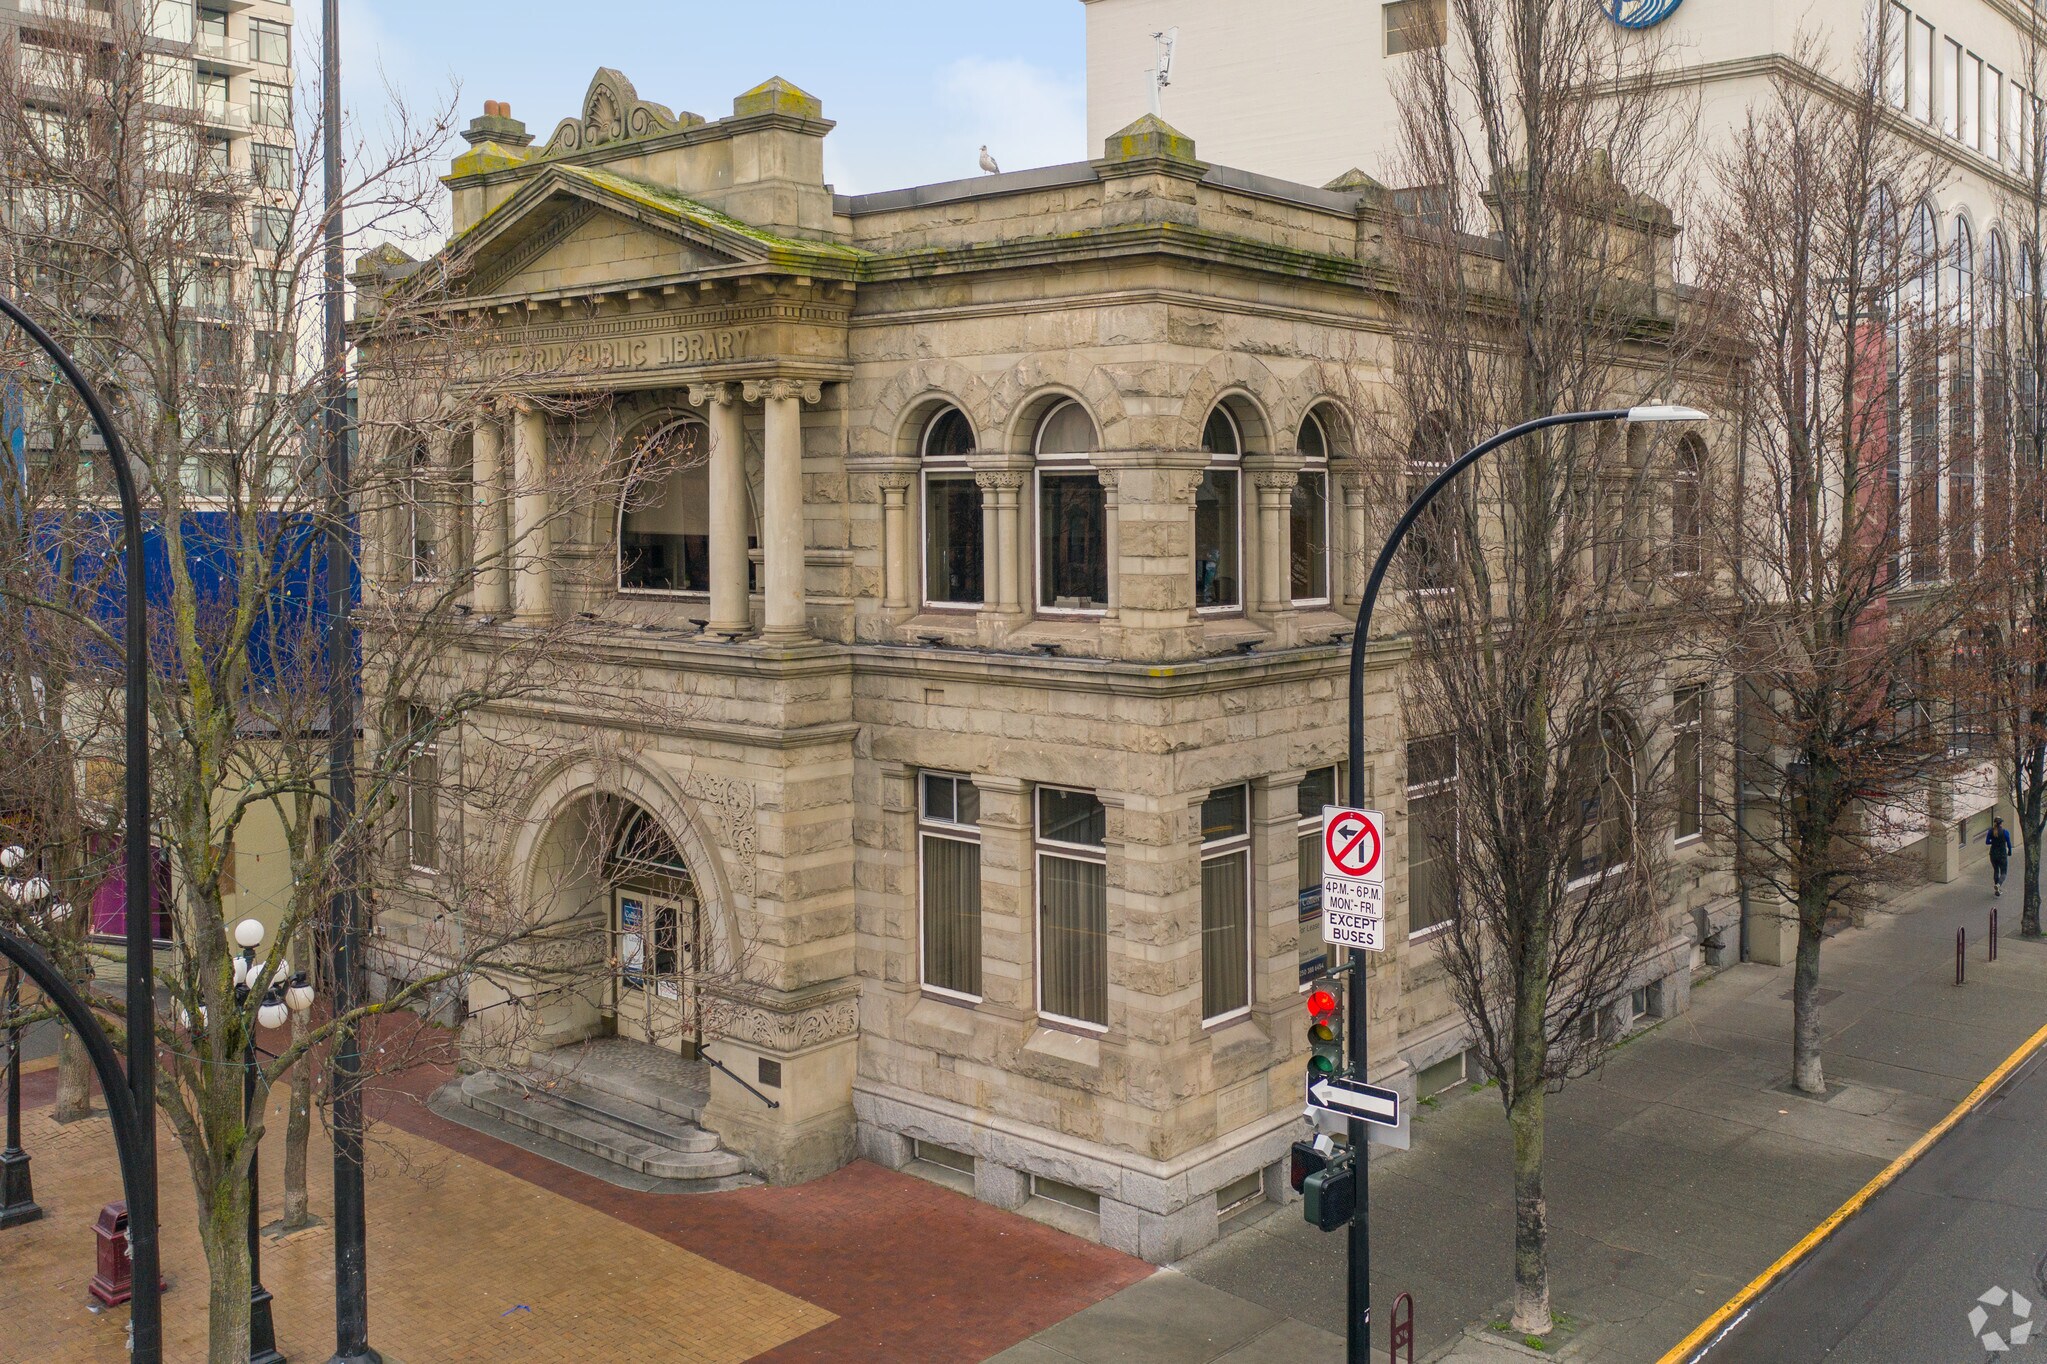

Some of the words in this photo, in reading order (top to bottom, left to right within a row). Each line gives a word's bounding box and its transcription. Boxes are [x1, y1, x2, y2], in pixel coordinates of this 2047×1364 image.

[576, 340, 647, 369] PUBLIC
[657, 330, 749, 364] LIBRARY
[1330, 913, 1377, 931] EXCEPT
[1333, 927, 1374, 945] BUSES
